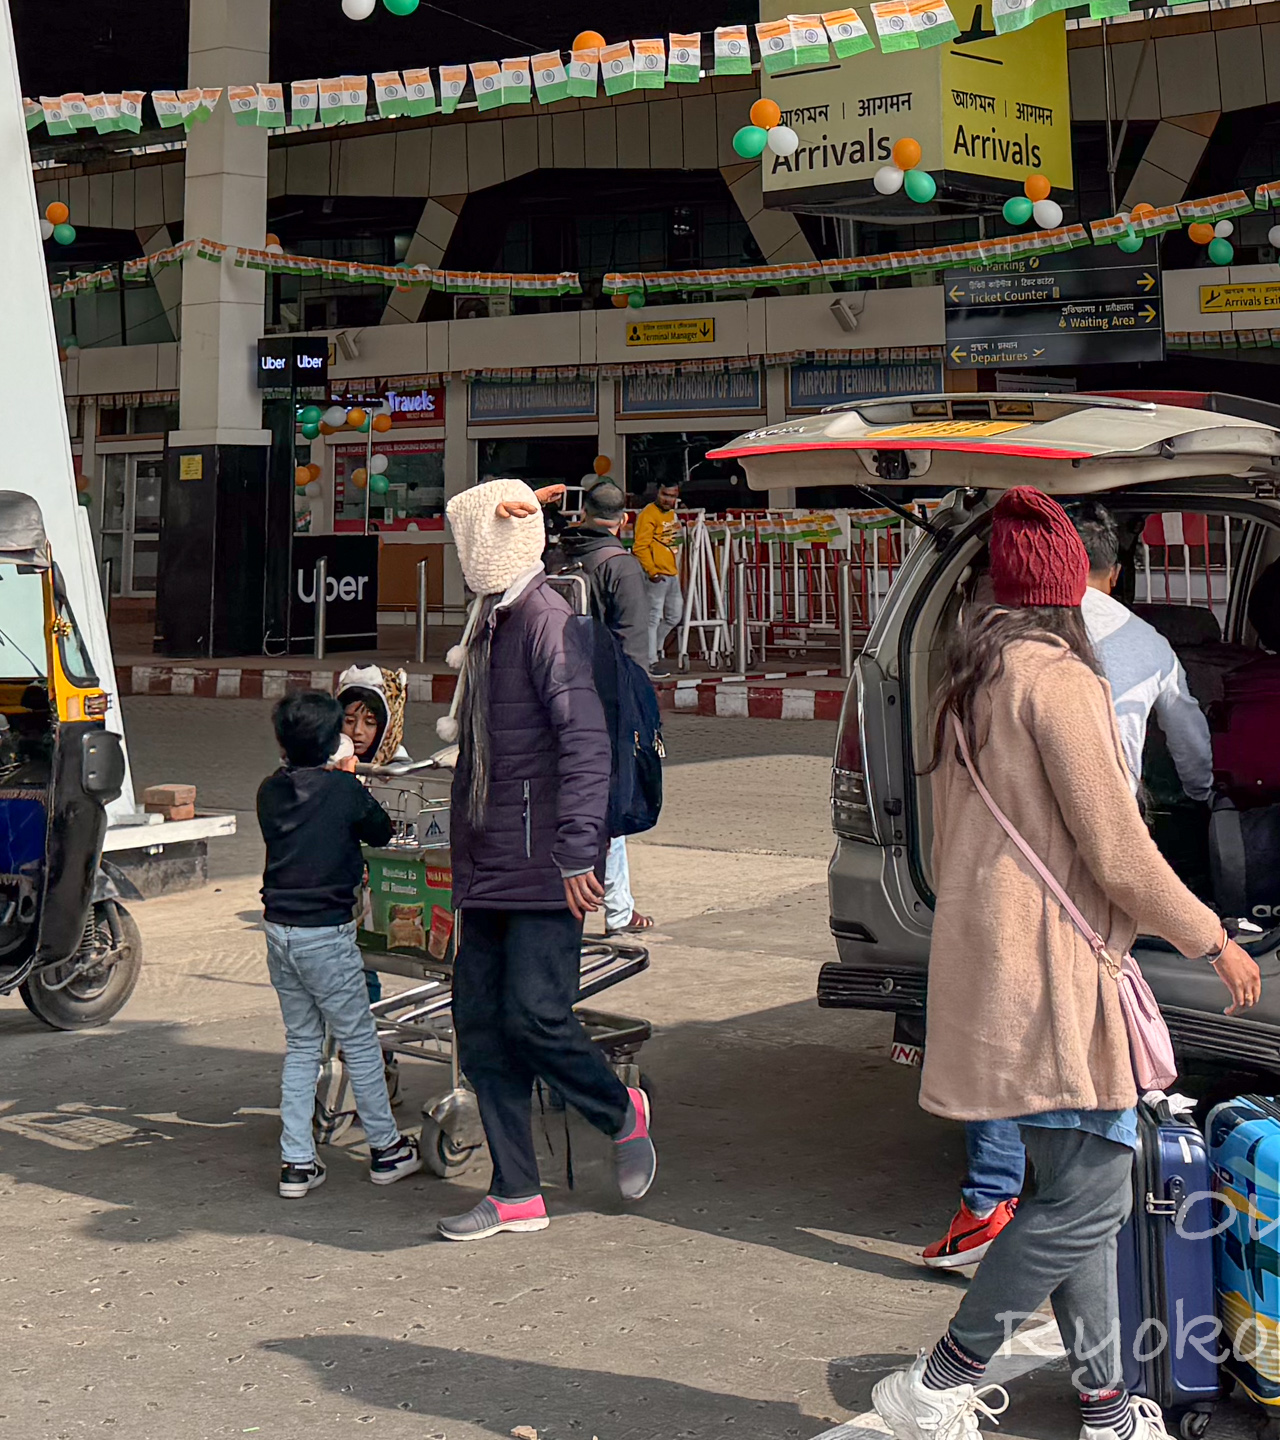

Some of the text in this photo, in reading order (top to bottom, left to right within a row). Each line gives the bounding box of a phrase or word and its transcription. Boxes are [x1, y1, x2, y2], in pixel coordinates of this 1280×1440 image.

[857, 92, 913, 117] आगमन
[951, 89, 996, 114] আগমন
[1015, 102, 1054, 127] आगमन
[771, 127, 892, 174] Arrivals
[953, 124, 1042, 169] Arrivals
[969, 261, 1026, 273] No Parking
[969, 289, 1049, 304] Ticket Counter
[1224, 296, 1262, 308] Arrivals
[1070, 316, 1135, 330] Waiting Area
[643, 331, 698, 342] Terminal Manager
[261, 356, 286, 370] Uber
[297, 354, 323, 369] Uber
[970, 352, 1028, 366] Departures
[669, 375, 717, 401] AUTHORITY
[717, 374, 729, 399] OF
[729, 372, 754, 398] INDIA
[798, 364, 936, 397] AIRPORT TERMINAL MANAGER
[385, 389, 436, 413] Travels
[375, 443, 393, 452] HOTEL
[394, 442, 420, 451] BOOKING
[297, 567, 369, 604] Uber
